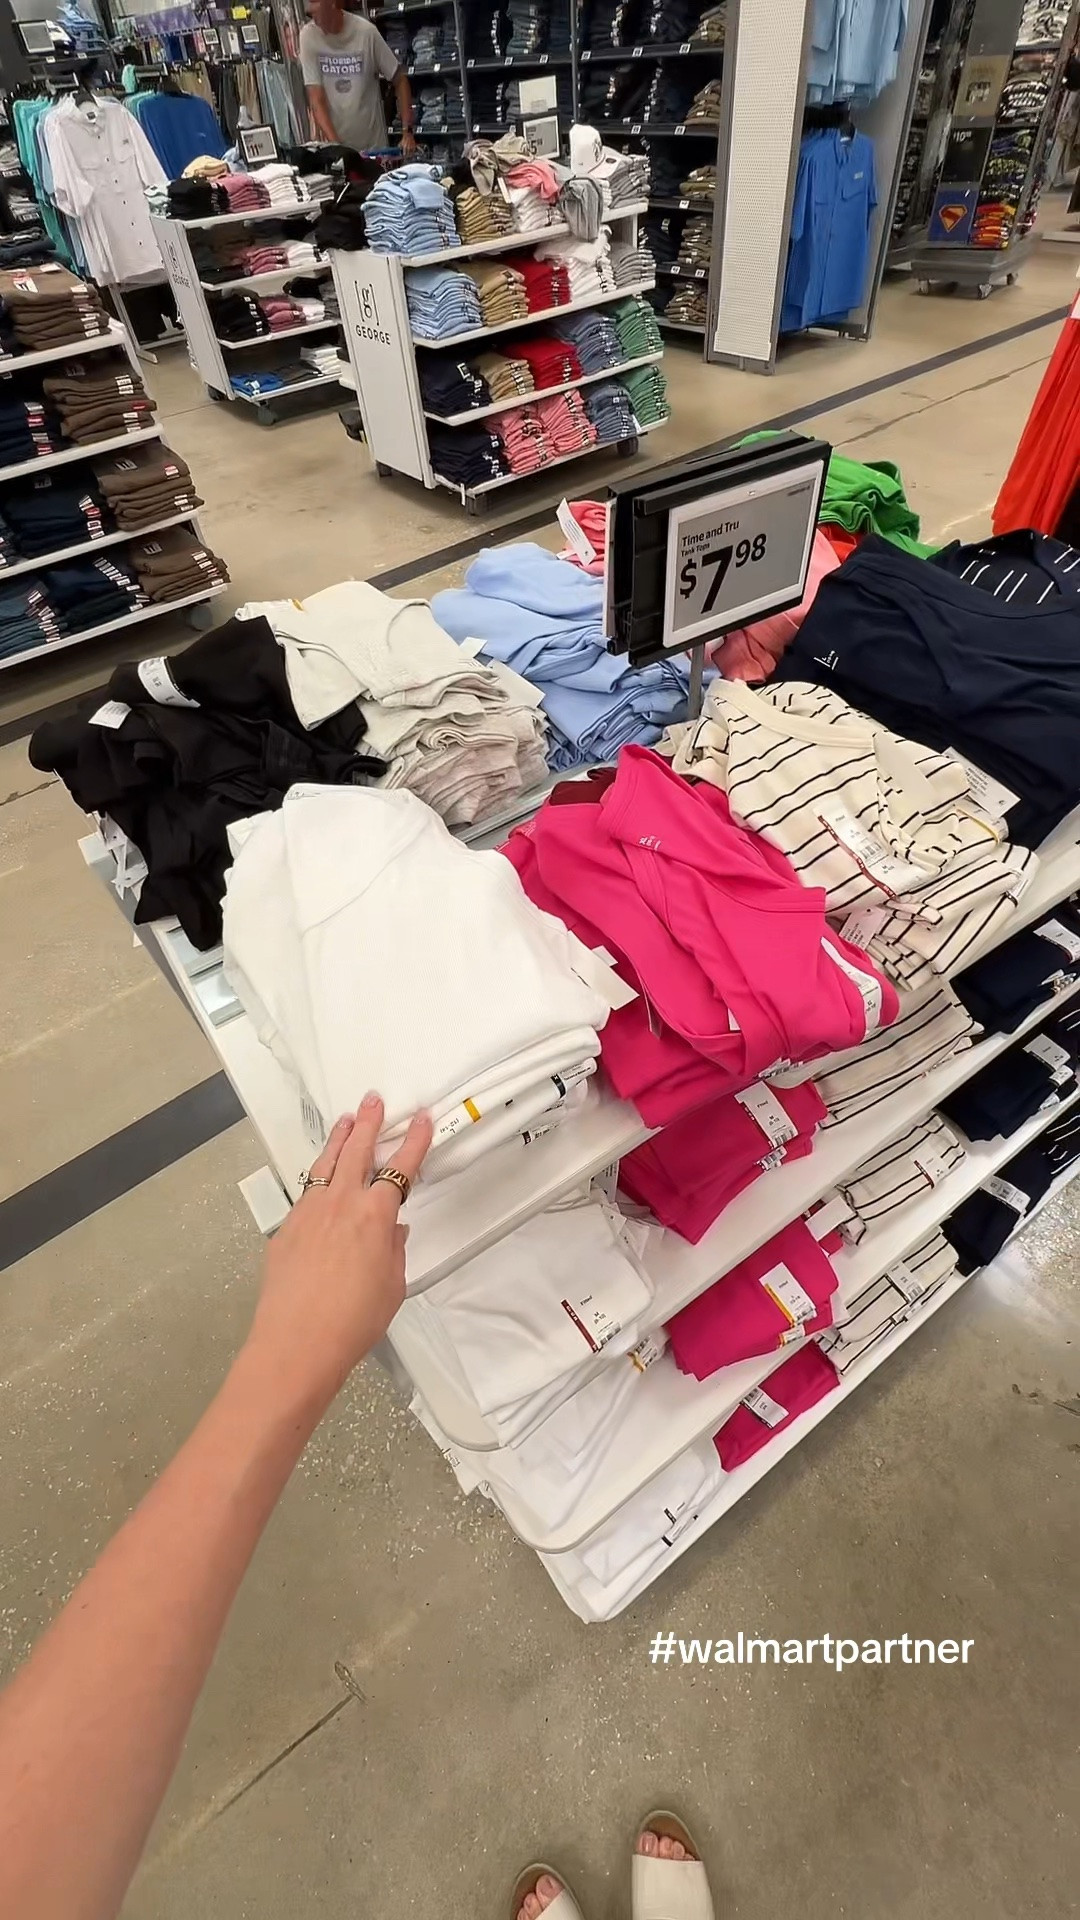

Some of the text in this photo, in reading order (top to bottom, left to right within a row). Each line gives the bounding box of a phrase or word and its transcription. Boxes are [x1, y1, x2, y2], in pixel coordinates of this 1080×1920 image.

[321, 63, 361, 74] GATORS
[355, 325, 391, 345] GEORGE
[681, 519, 740, 548] Time and Tru
[681, 542, 711, 558] Tank Tops
